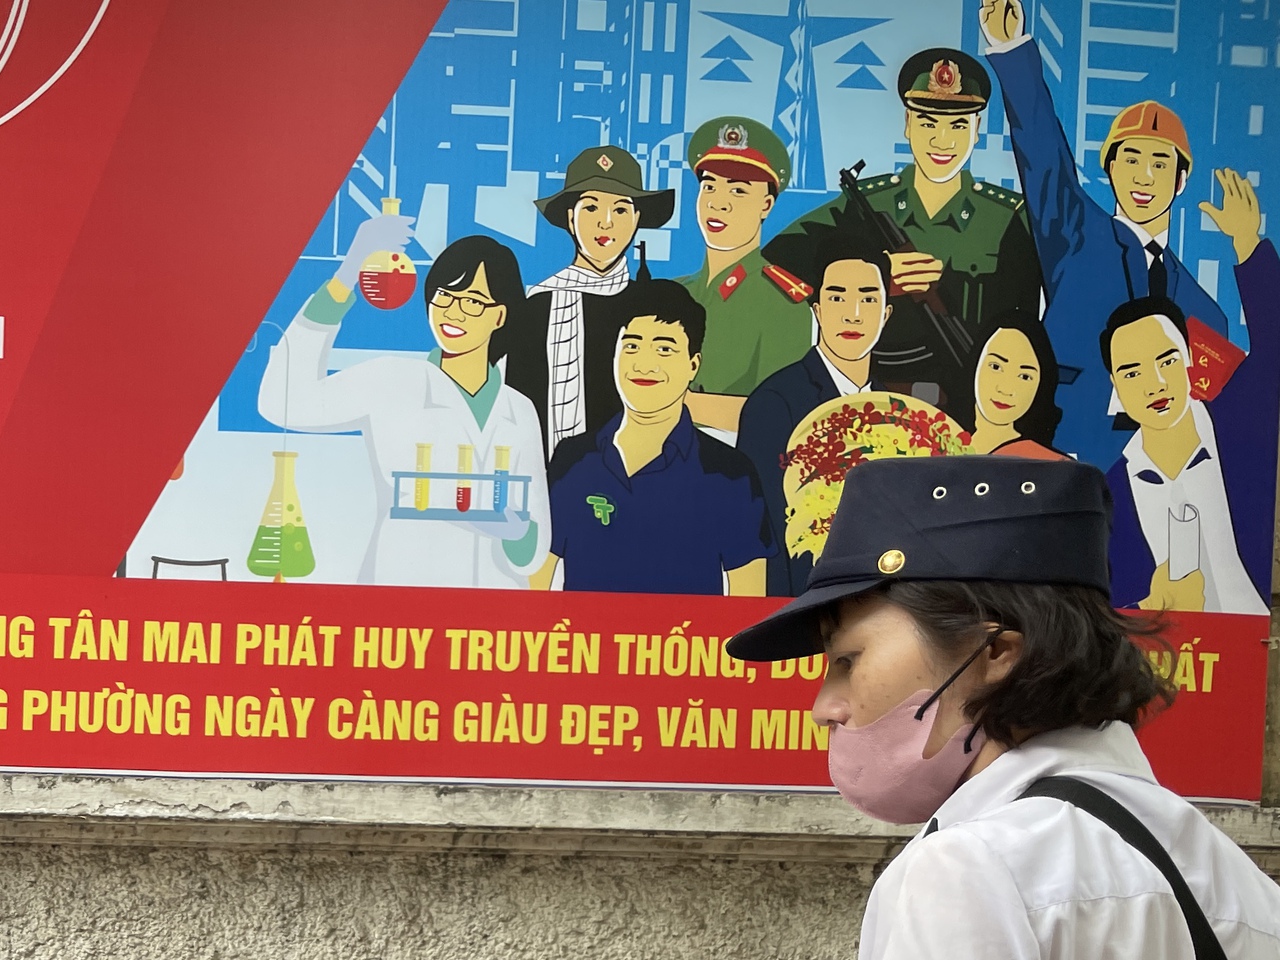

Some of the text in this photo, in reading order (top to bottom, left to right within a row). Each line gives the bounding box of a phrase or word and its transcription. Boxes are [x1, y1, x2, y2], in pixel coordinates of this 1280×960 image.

[48, 609, 129, 662] TÂN
[142, 620, 222, 665] MAI
[235, 615, 342, 667] PHÁT
[352, 626, 434, 670] HUY
[445, 618, 601, 674] TRUYỀN
[22, 681, 191, 736] PHƯỜNG
[204, 687, 316, 739] NGÀY
[327, 689, 440, 742] CÀNG
[453, 693, 548, 745] GIÀU
[559, 703, 643, 755] ĐẸP,
[657, 698, 738, 749] VĂN
[750, 708, 830, 751] MIN
